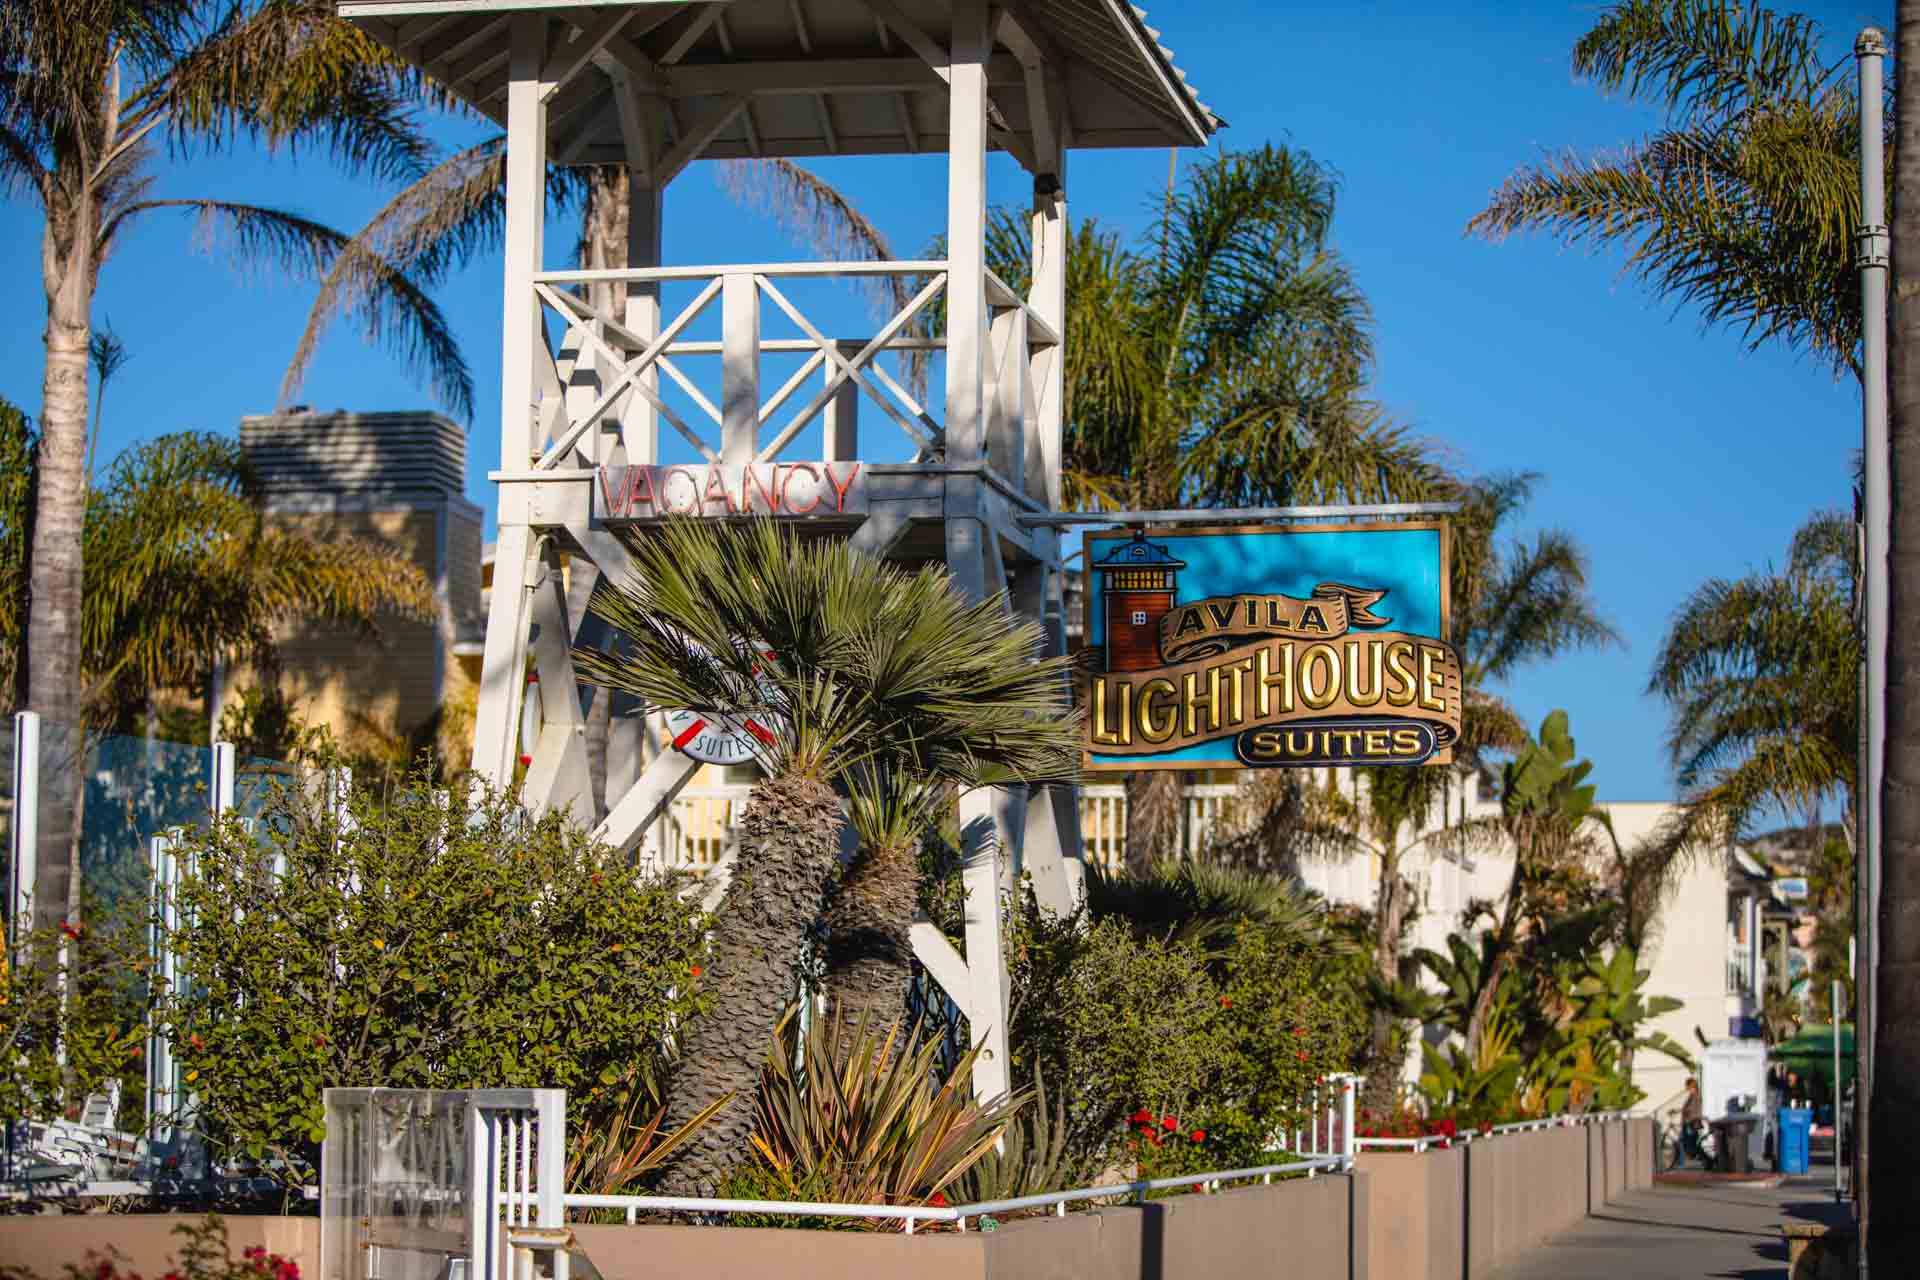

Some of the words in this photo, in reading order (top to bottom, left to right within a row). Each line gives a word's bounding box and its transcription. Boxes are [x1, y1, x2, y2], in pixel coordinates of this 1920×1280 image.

[599, 463, 860, 516] VACANCY
[1173, 598, 1331, 640] AVILA
[1091, 640, 1447, 746] LIGHTHOUSE
[695, 735, 754, 758] SUITES
[1252, 728, 1422, 757] SUITES
